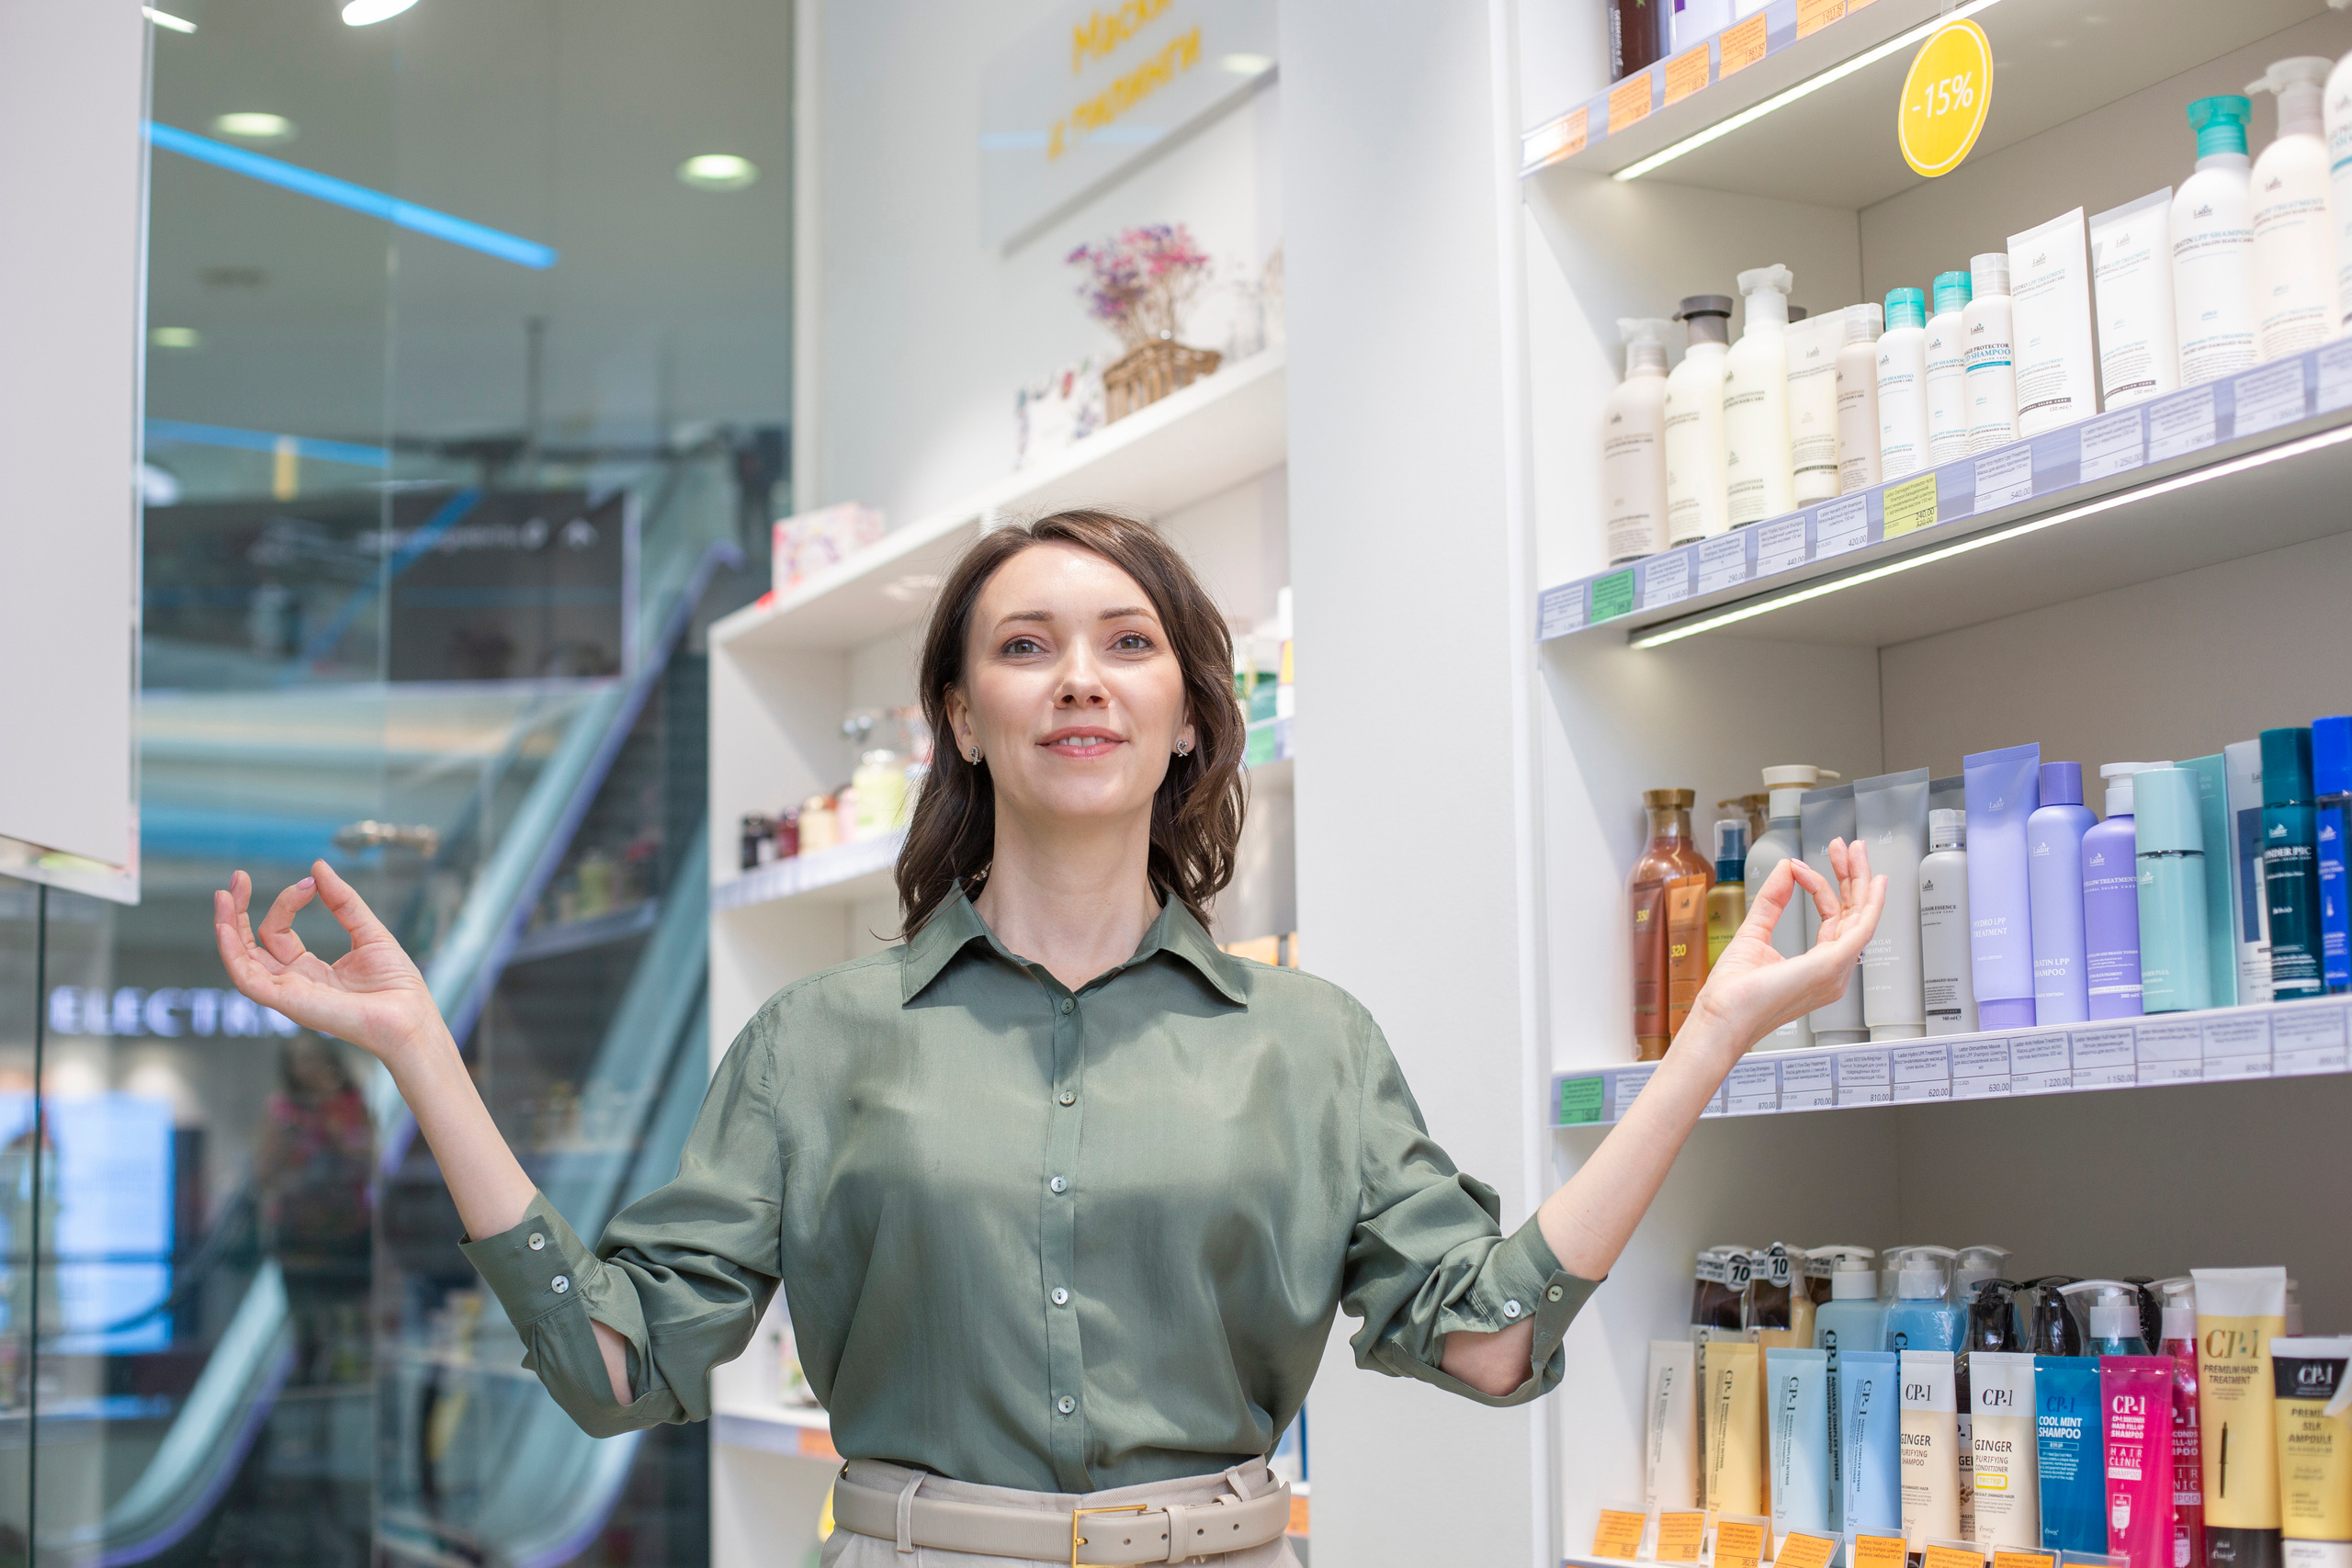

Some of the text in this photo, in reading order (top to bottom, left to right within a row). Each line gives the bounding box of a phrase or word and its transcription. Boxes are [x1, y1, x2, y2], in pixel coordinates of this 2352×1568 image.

[1912, 71, 1973, 118] -15%
[1973, 343, 2009, 352] PROTECTOR
[1971, 348, 2011, 360] SHAMPOO
[2010, 488, 2031, 500] 540,00
[1916, 508, 1934, 520] 240,00
[1849, 535, 1867, 547] 420,00
[2033, 844, 2050, 854] Lador
[2089, 854, 2105, 864] Lador
[1973, 918, 2006, 928] HYDRO LPP
[1973, 928, 2007, 938] TREATMENT
[1671, 943, 1687, 957] 320
[2049, 1077, 2070, 1087] 220,00
[1929, 1088, 1948, 1097] 620,00
[1989, 1083, 2009, 1092] 630,00
[1814, 1097, 1831, 1106] 870,00
[1871, 1093, 1889, 1102] 810,00
[1758, 1101, 1775, 1111] 870,00
[1772, 1258, 1788, 1274] 10
[1732, 1265, 1750, 1281] 10
[2205, 1329, 2261, 1359] CP-1
[1826, 1329, 1837, 1373] CP-1
[2204, 1364, 2259, 1374] PREMIUM HAIR
[2298, 1362, 2334, 1385] CP-1
[2209, 1375, 2251, 1385] TREATMENT
[1787, 1376, 1800, 1411] CP-1
[1905, 1383, 1931, 1401] CP-1
[1860, 1380, 1872, 1415] CP-1
[1983, 1389, 2013, 1406] CP-1
[2046, 1395, 2075, 1413] CP-1
[2113, 1395, 2146, 1415] CP-1
[2039, 1416, 2083, 1427] COOL MINT
[2302, 1422, 2322, 1431] SILK
[2039, 1427, 2081, 1439] SHAMPOO
[2111, 1430, 2144, 1439] SHAMPOO
[1901, 1433, 1931, 1446] GINGER
[2289, 1435, 2333, 1444] AMPOULE
[1975, 1439, 2012, 1452] GINGER
[1901, 1450, 1928, 1458] PURIFYING
[1976, 1455, 2008, 1464] PURIFYING
[2109, 1458, 2141, 1468] CLINIC
[1975, 1464, 2008, 1472] CONDITIONER
[2109, 1469, 2141, 1478] SHAMPOO
